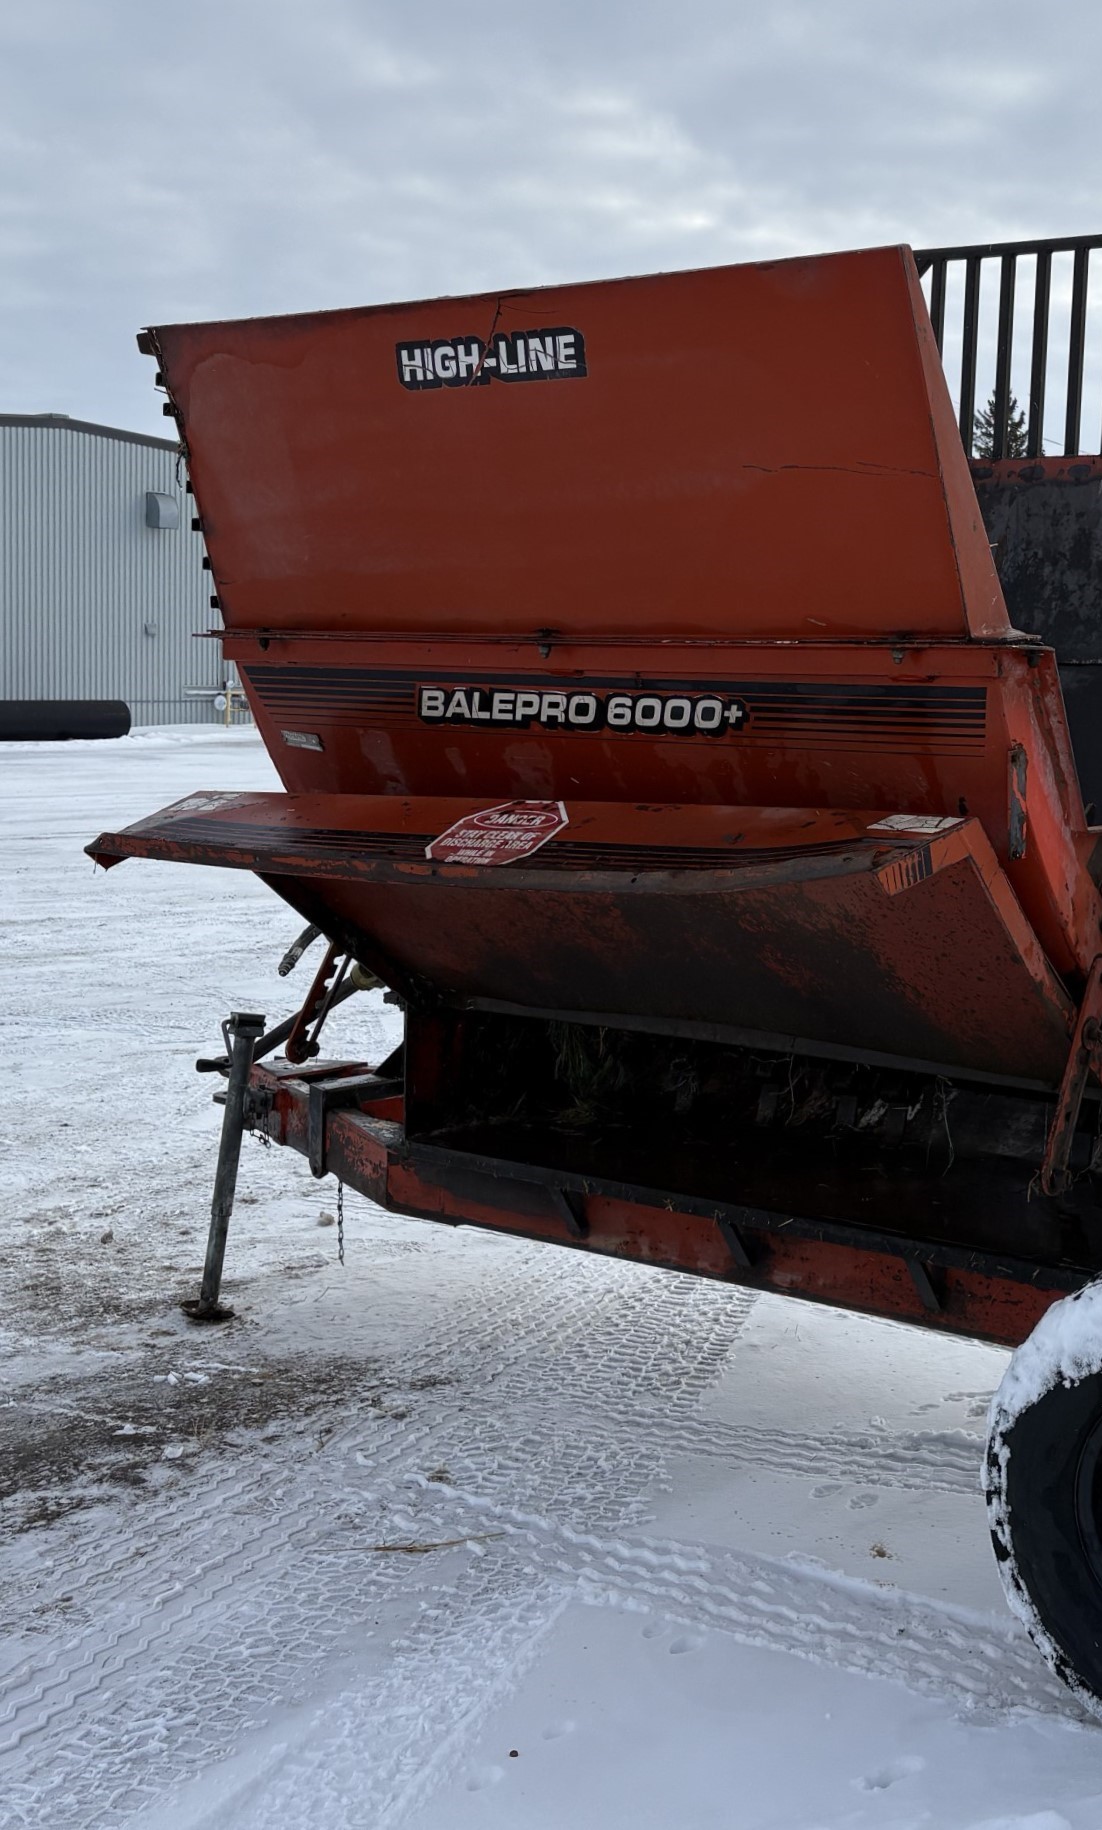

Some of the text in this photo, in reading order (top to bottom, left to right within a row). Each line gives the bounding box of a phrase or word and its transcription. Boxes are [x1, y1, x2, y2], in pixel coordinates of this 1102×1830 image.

[400, 333, 578, 383] HIGH-LINE
[421, 690, 743, 729] BALEPRO 6000+
[440, 838, 504, 849] DISCHARGE
[455, 829, 539, 841] STAY CLEAR OF
